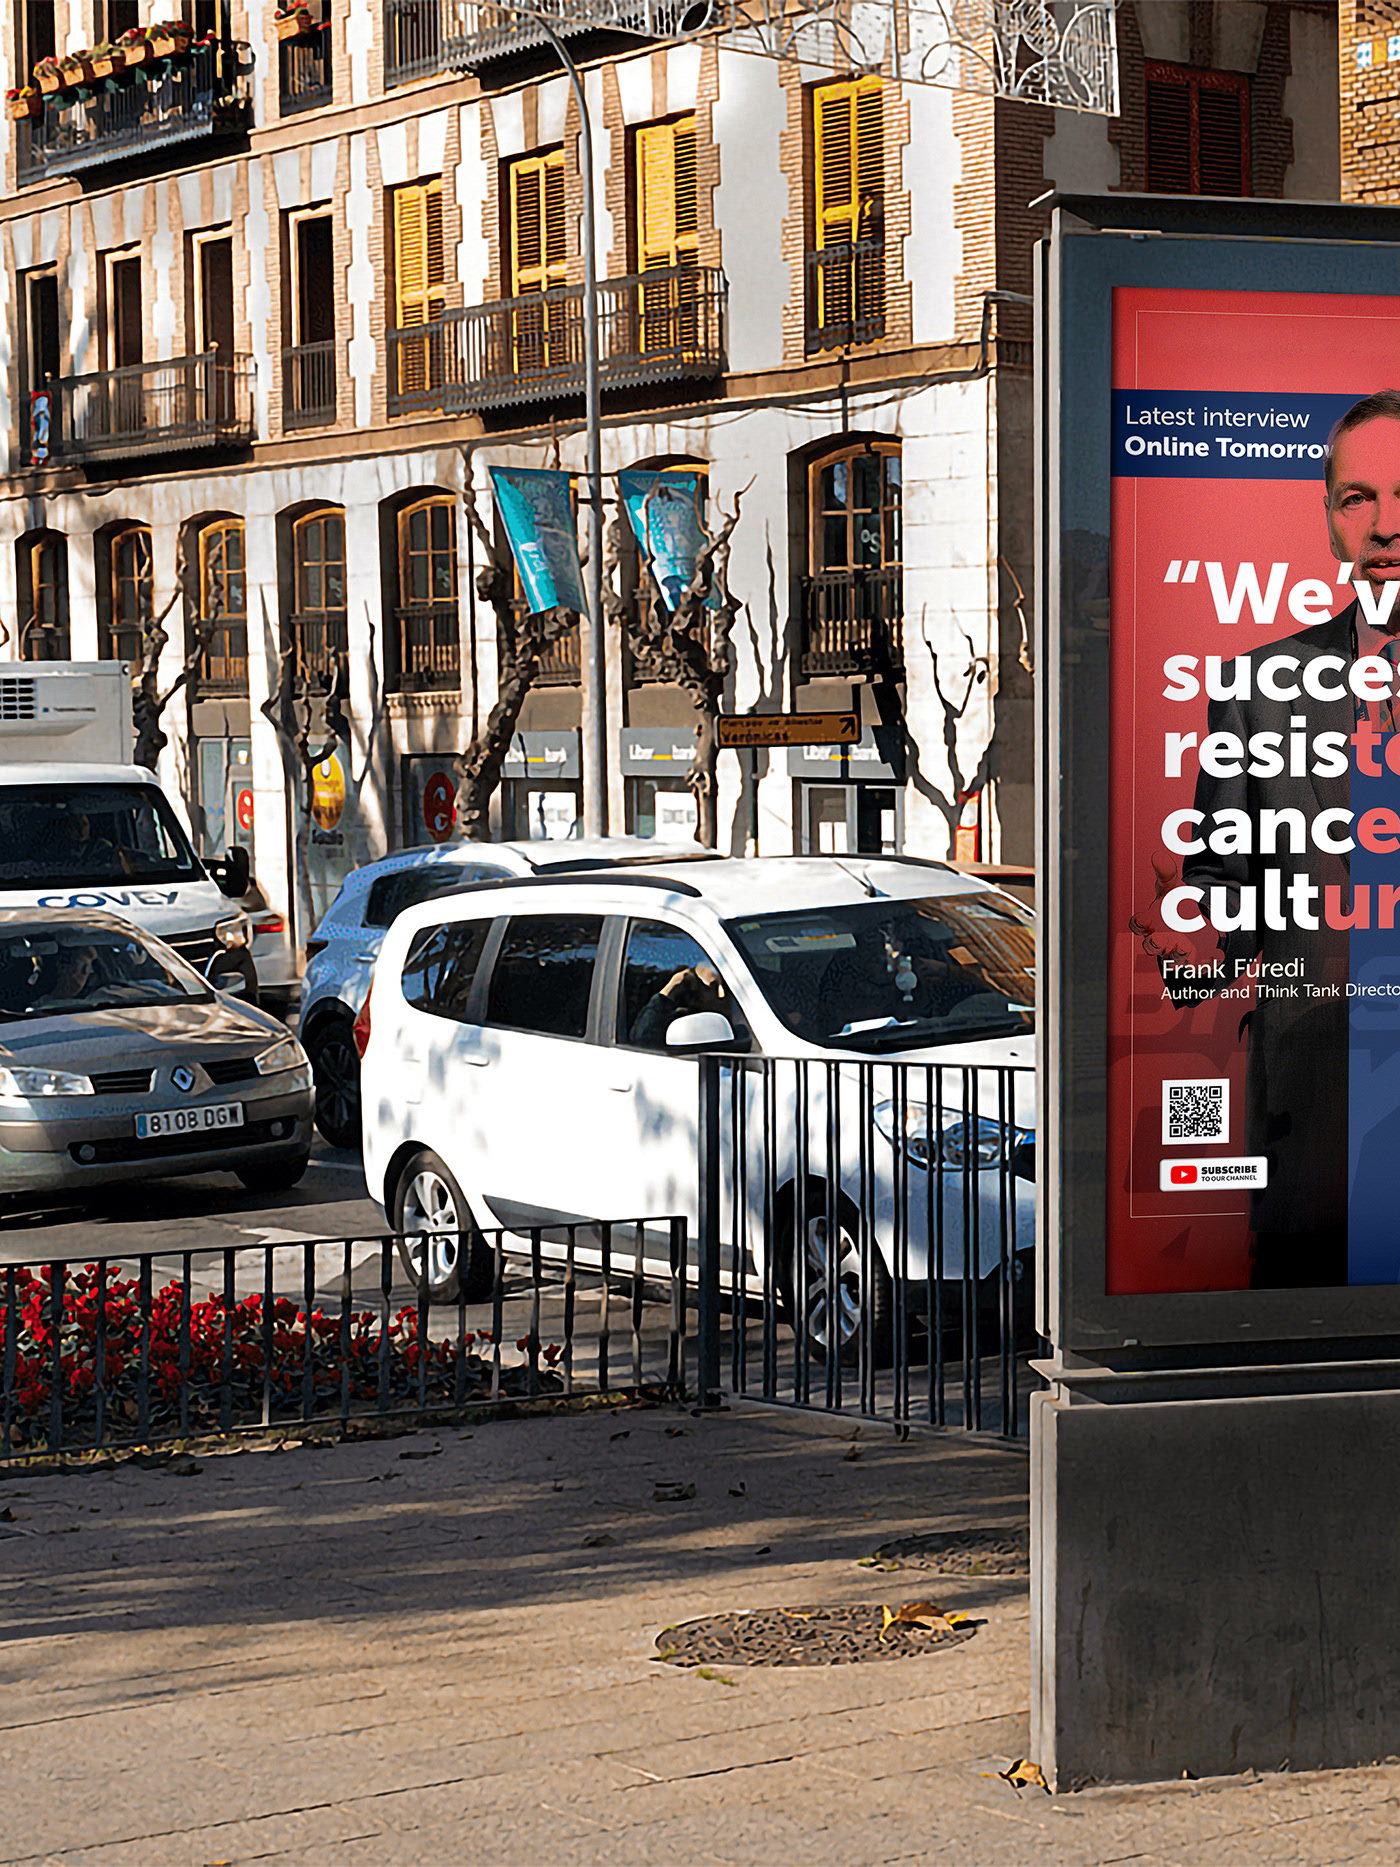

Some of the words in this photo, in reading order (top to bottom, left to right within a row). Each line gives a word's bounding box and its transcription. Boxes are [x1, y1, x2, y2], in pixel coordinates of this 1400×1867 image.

[1126, 405, 1195, 426] Latest
[1203, 407, 1310, 428] interview
[1124, 435, 1210, 457] Online
[1163, 959, 1226, 979] Frank
[1234, 957, 1305, 978] Füredi
[1161, 985, 1216, 1000] Author
[1220, 985, 1250, 998] and
[1255, 983, 1299, 998] Think
[1303, 983, 1341, 997] Tank
[150, 1110, 198, 1133] 8108
[1201, 1165, 1258, 1175] SUBSCRIBE
